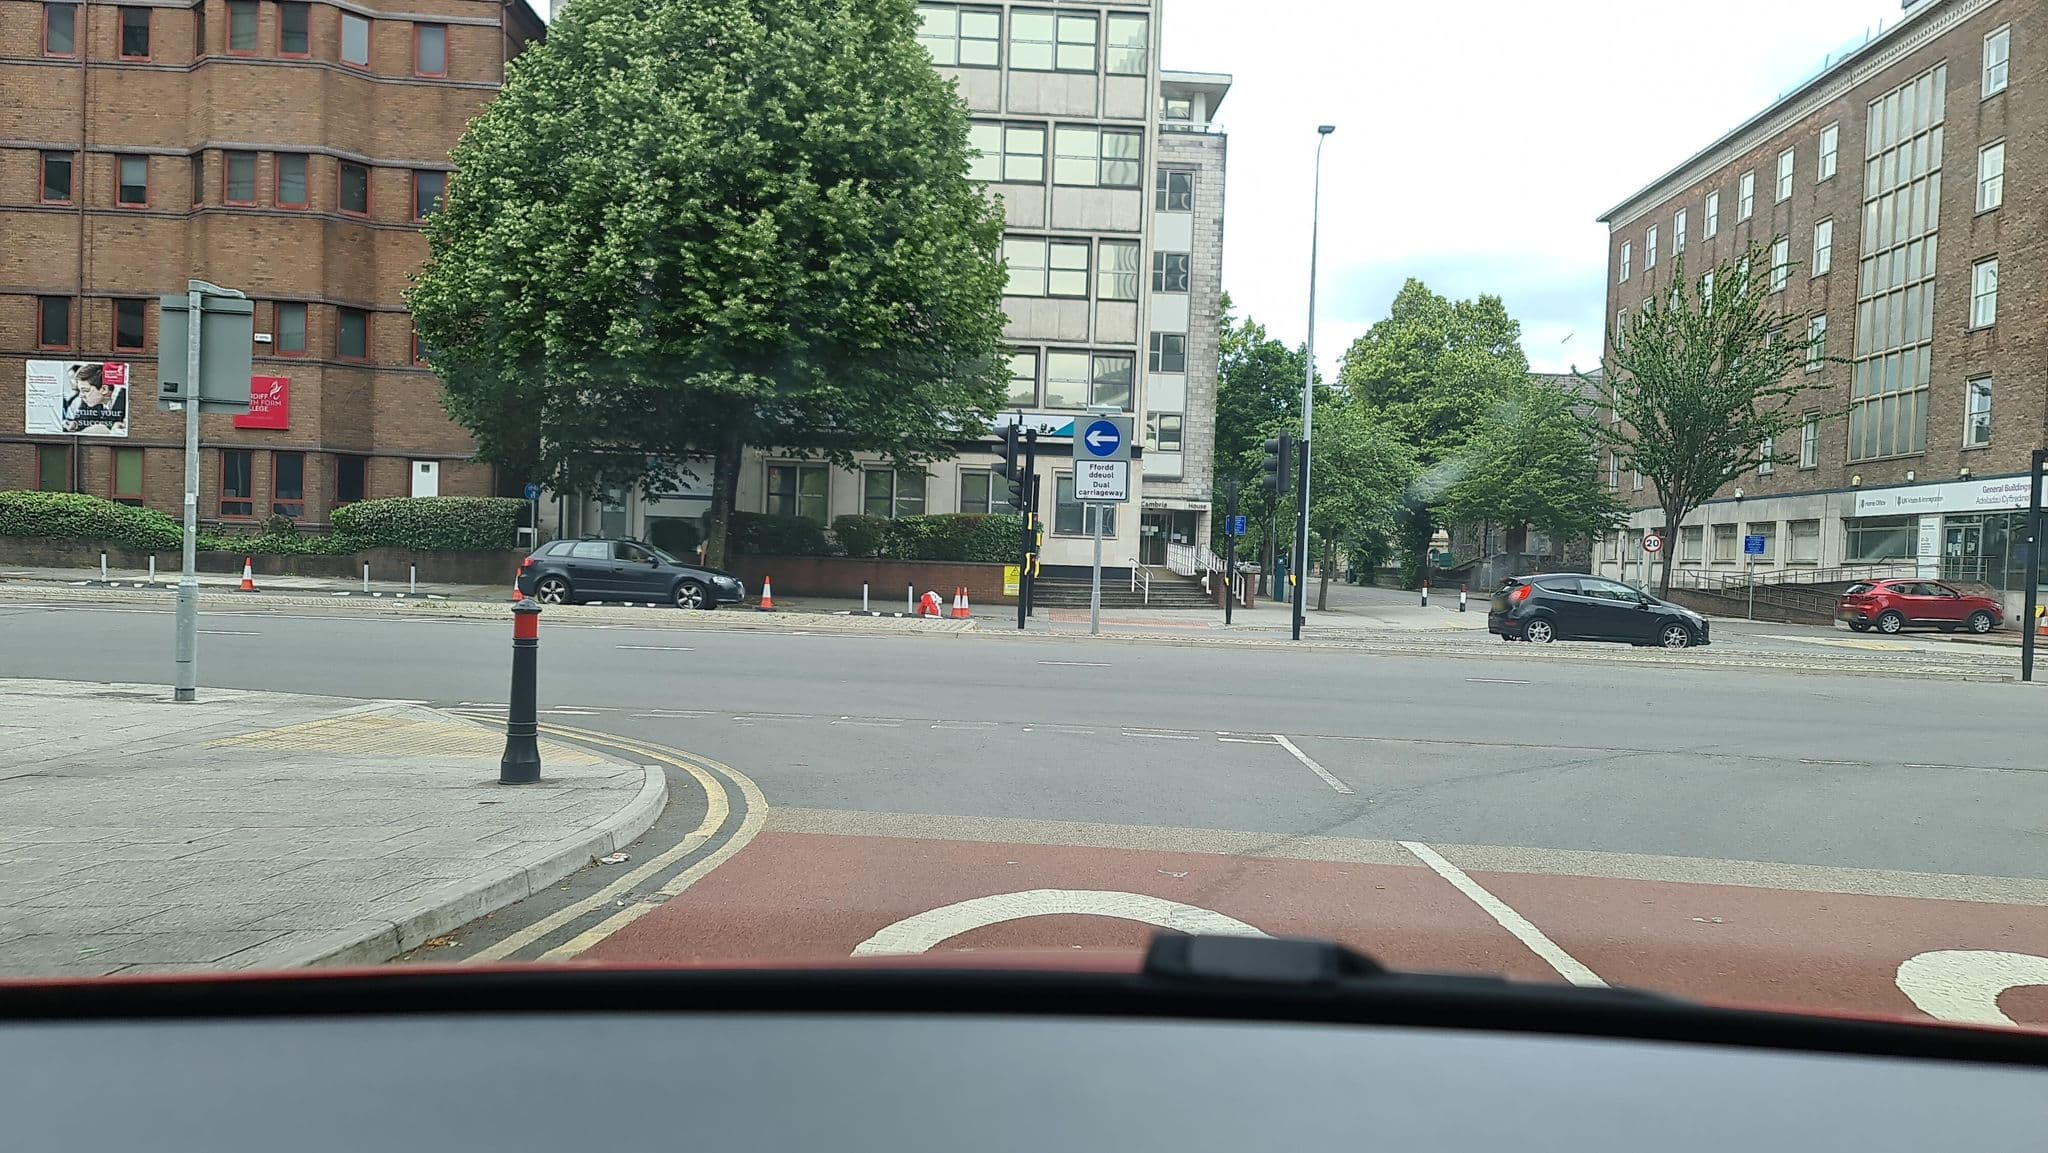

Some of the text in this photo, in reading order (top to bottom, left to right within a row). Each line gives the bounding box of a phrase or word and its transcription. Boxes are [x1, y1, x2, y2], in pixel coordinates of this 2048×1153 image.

[100, 409, 122, 419] your
[78, 419, 113, 427] success
[1078, 489, 1124, 497] carriageway
[1982, 485, 2004, 493] General
[1646, 539, 1659, 547] 20
